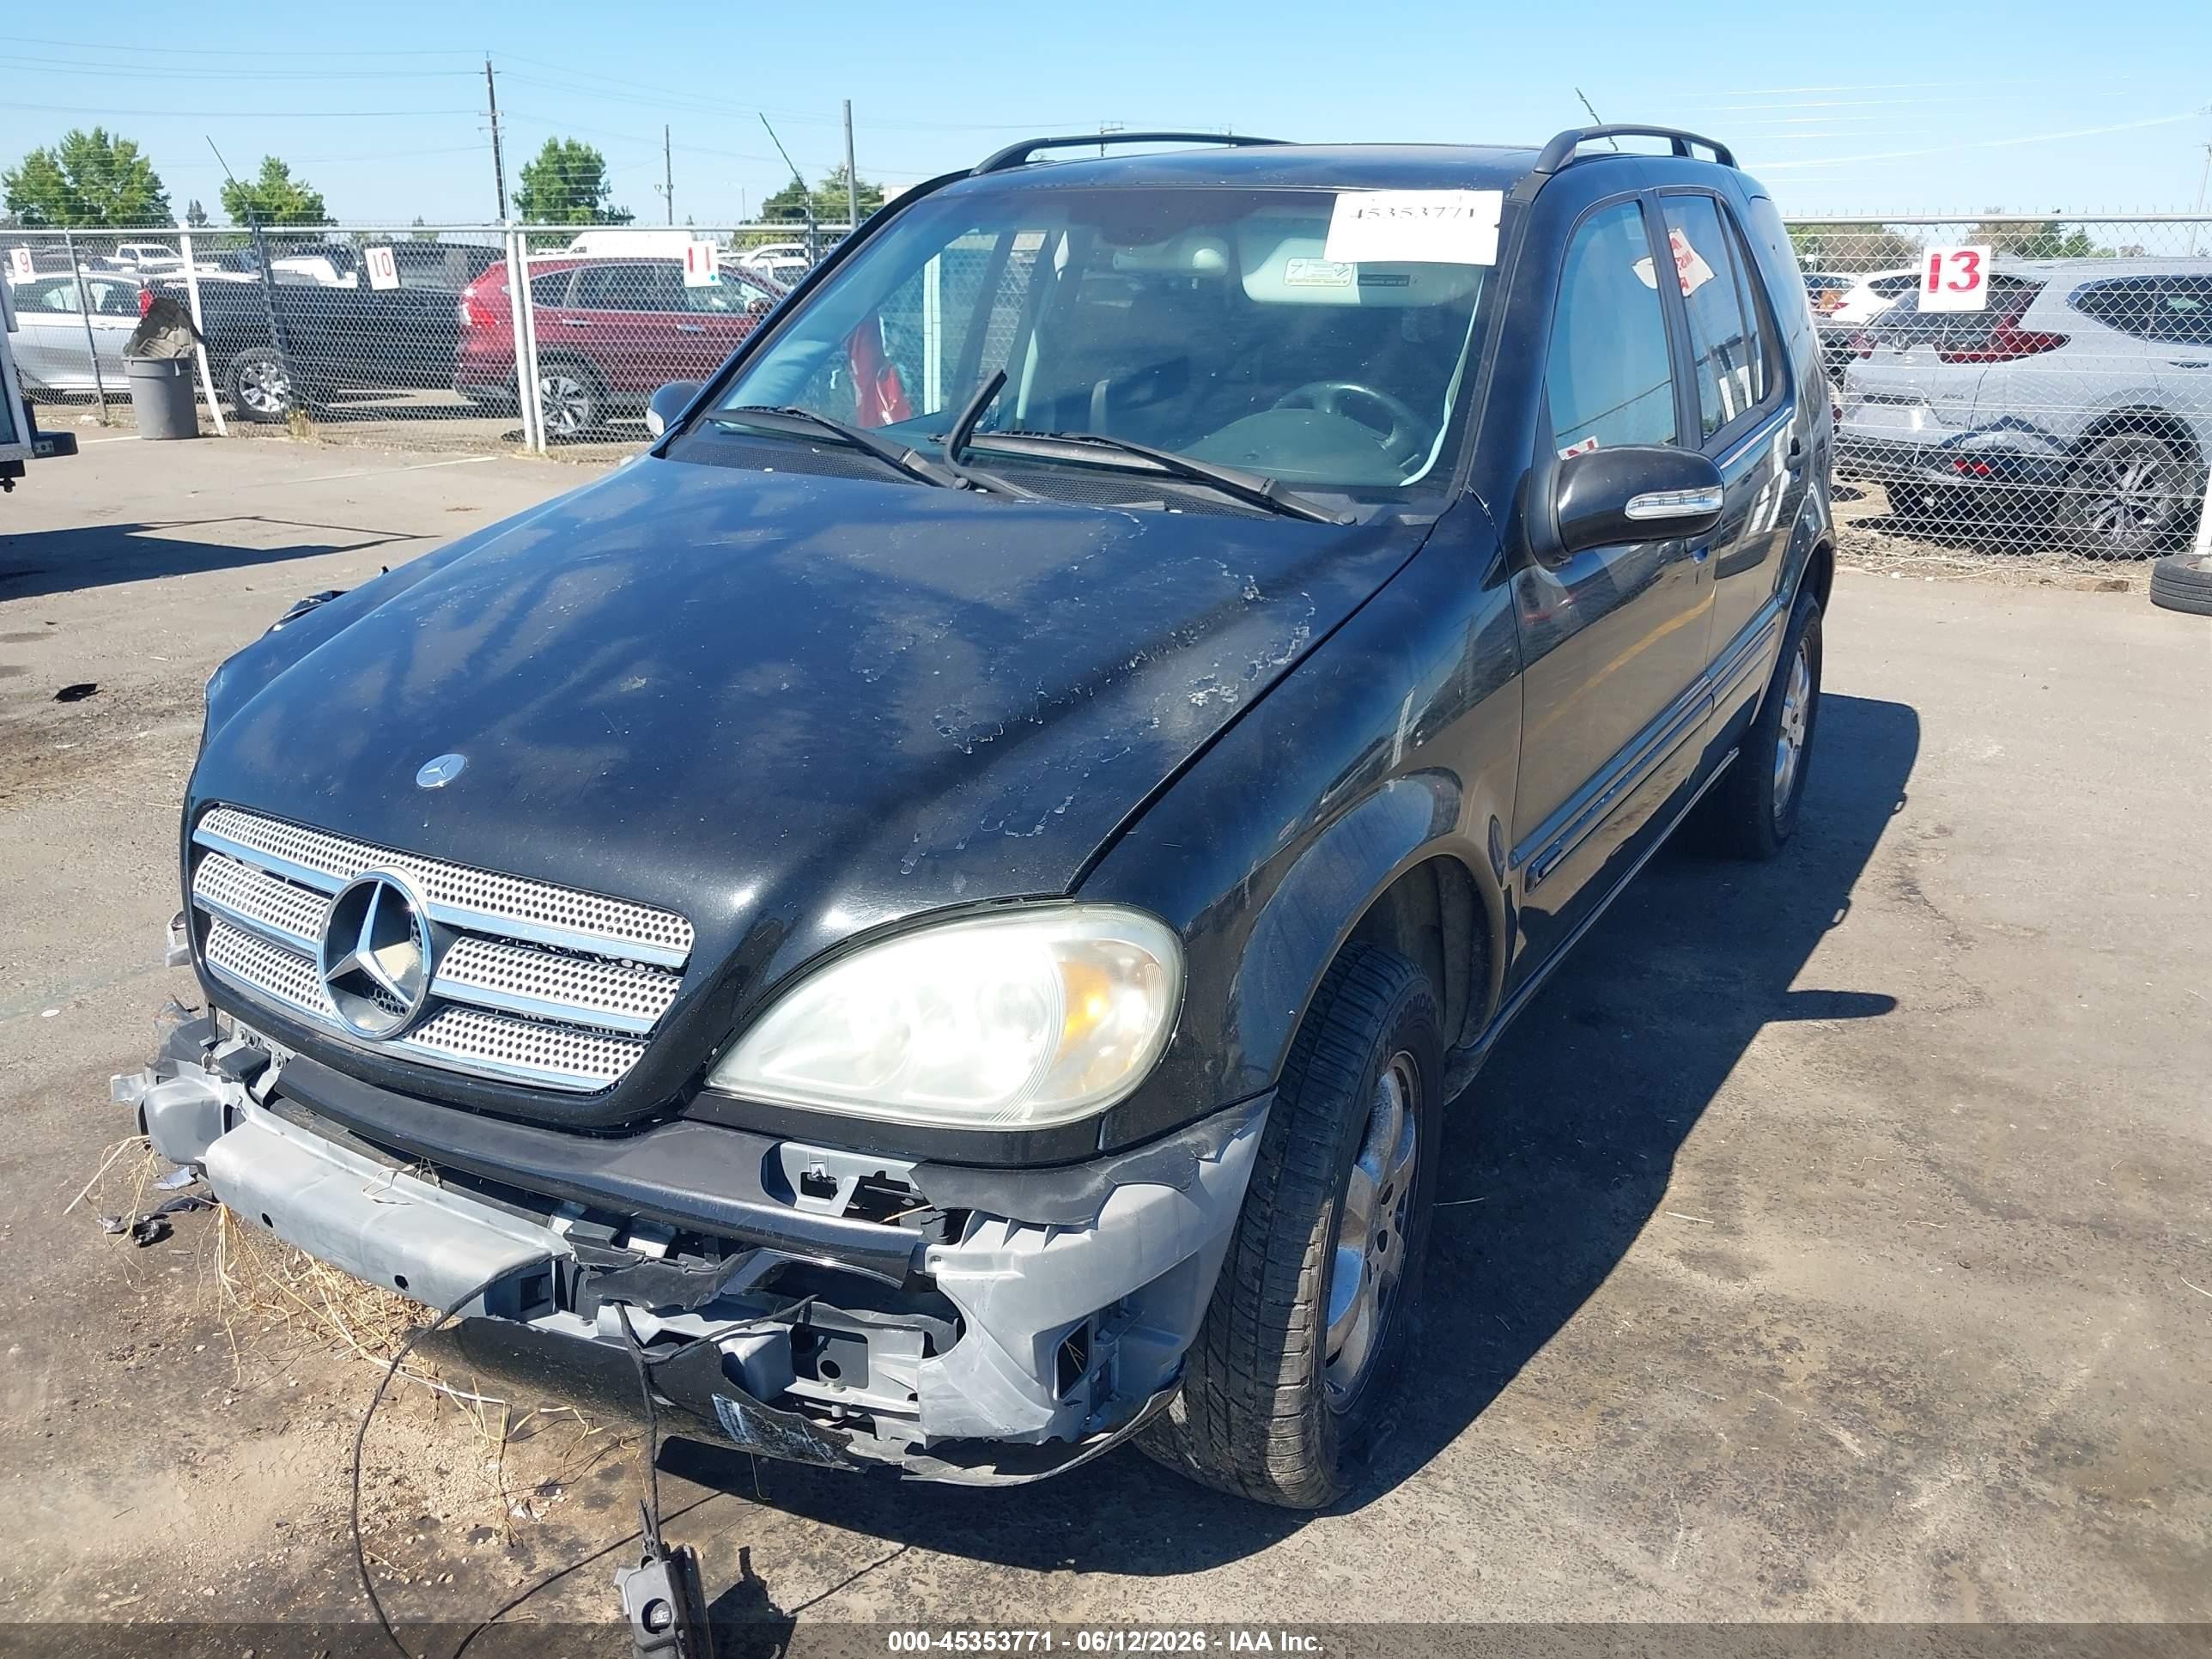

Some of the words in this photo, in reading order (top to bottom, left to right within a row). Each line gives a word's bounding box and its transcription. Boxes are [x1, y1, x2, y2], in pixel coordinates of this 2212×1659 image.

[20, 252, 29, 273] 9
[373, 252, 392, 277] 10
[688, 246, 710, 273] 11
[1928, 251, 1980, 293] 13
